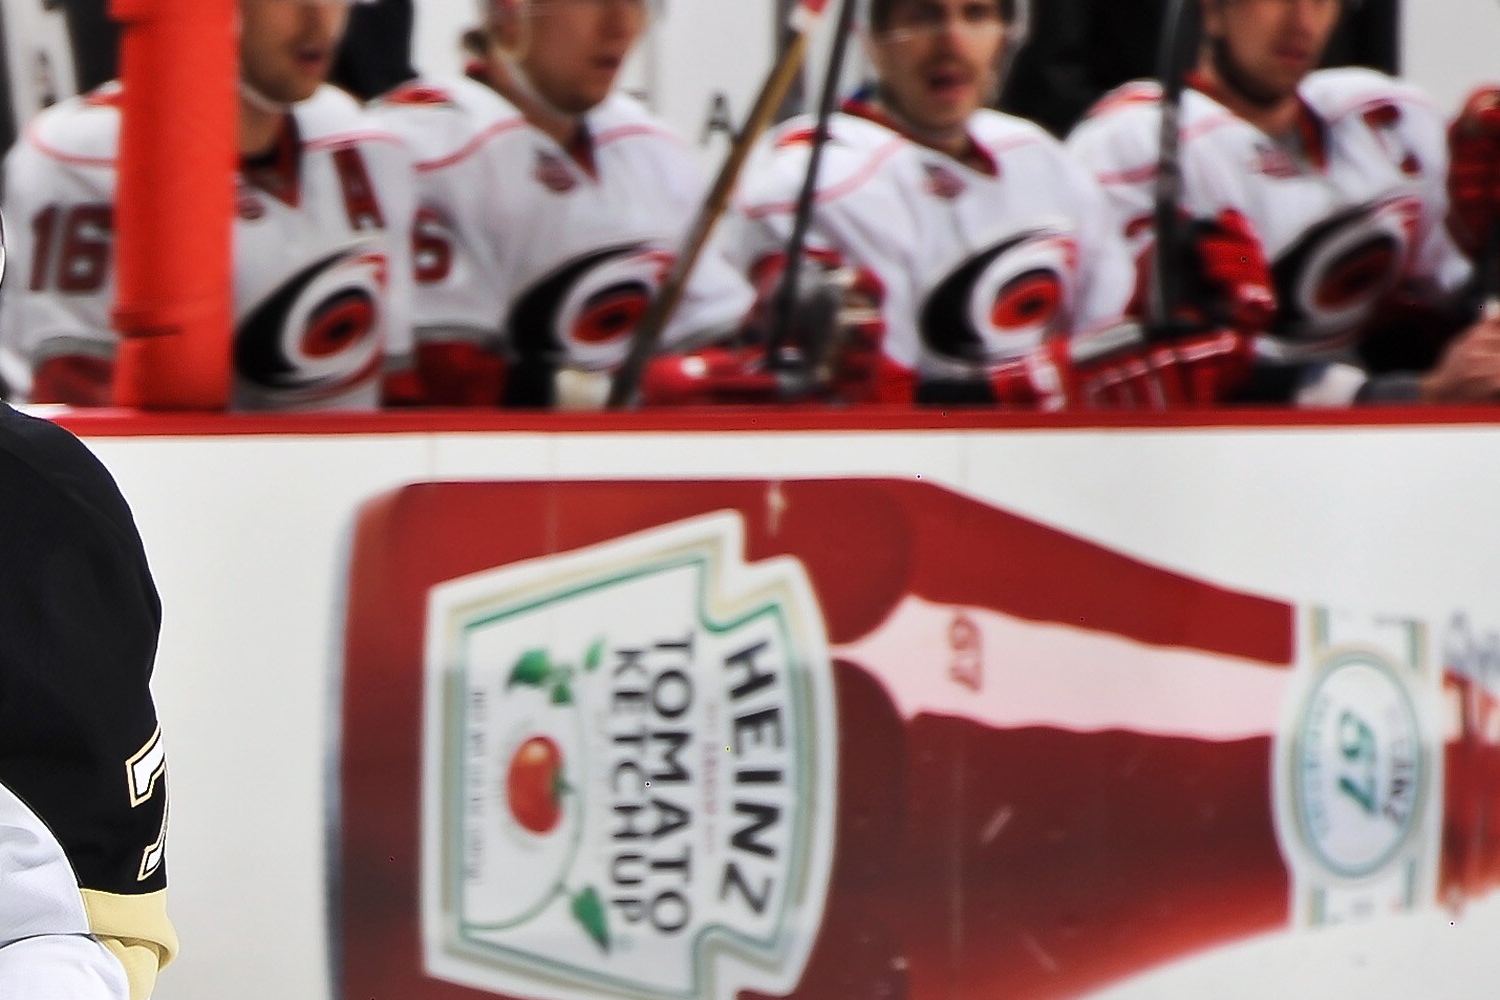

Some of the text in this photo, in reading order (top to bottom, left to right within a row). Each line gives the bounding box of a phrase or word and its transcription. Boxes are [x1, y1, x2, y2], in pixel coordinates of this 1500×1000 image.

[611, 649, 649, 923] KETCHUP
[650, 632, 693, 932] TOMATO
[720, 640, 782, 916] HEINZ
